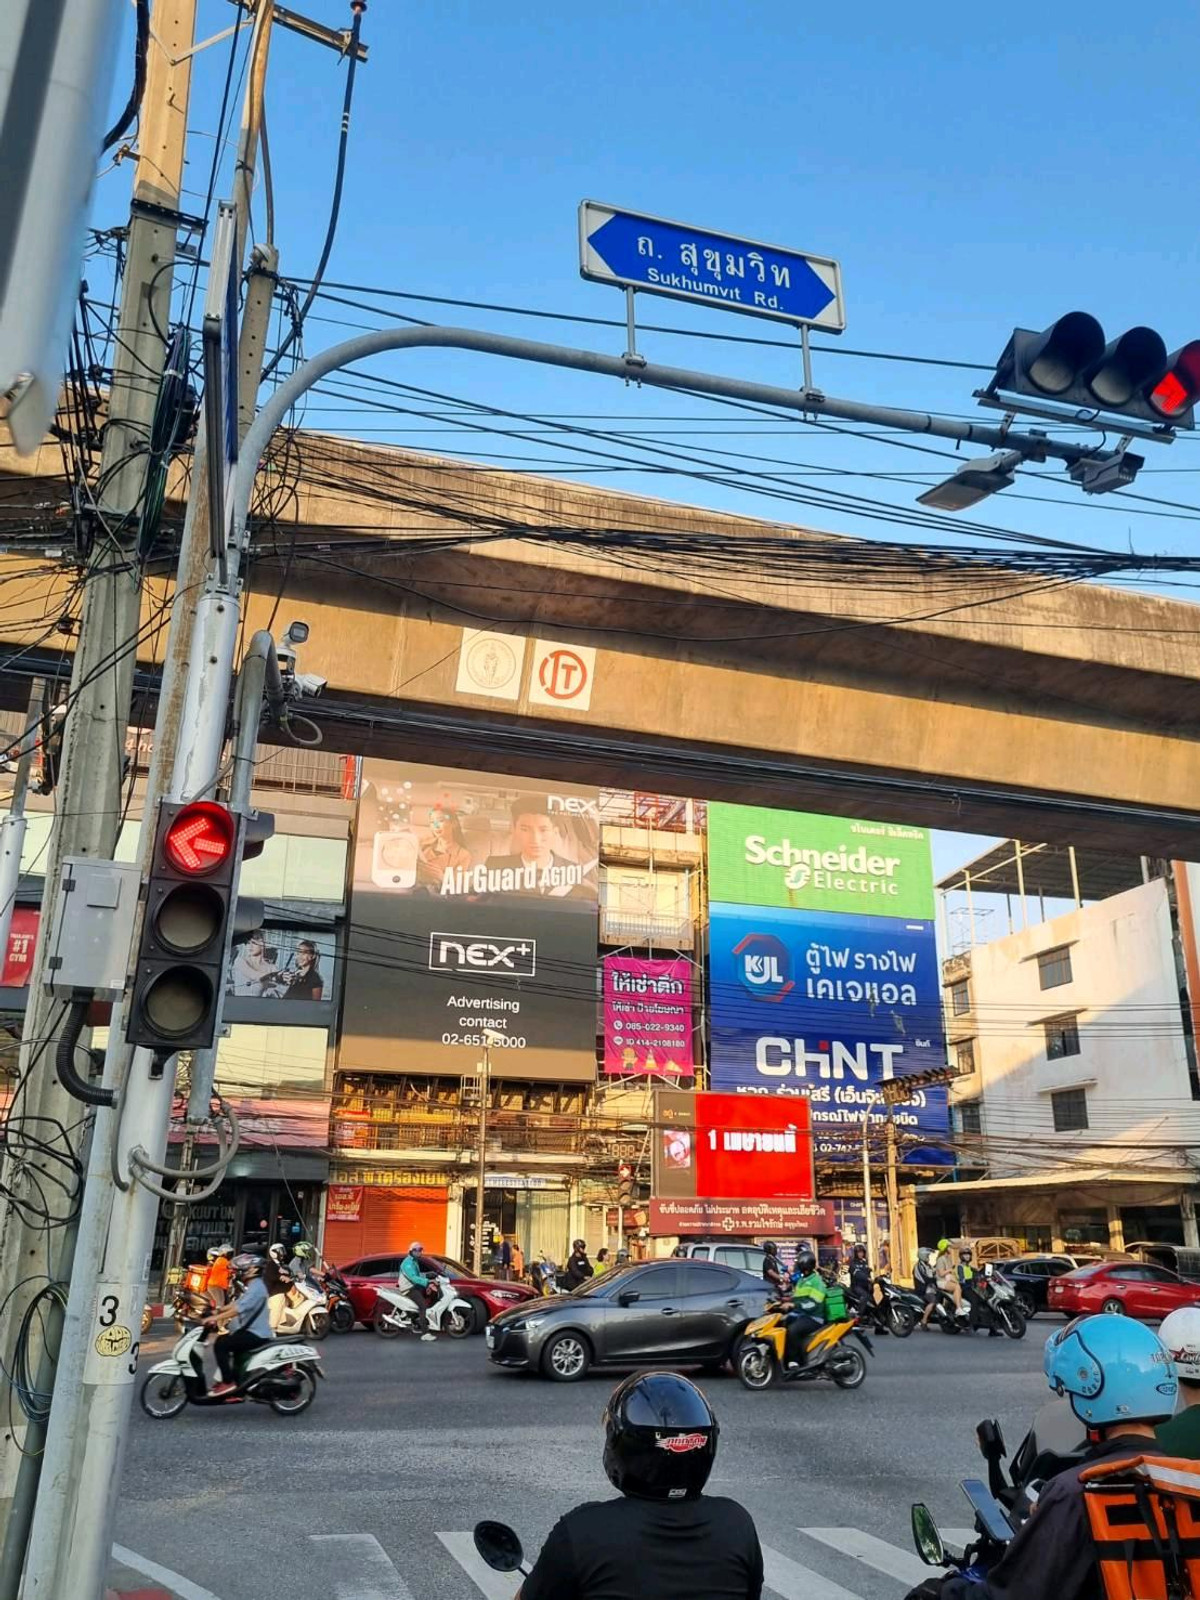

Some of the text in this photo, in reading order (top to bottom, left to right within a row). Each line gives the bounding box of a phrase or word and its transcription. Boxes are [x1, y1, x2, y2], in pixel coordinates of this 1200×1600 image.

[637, 235, 791, 289] ถ. สุขุมวิท
[648, 267, 784, 310] Sukhumvit Rd.
[745, 835, 901, 877] Schneider
[440, 861, 536, 896] AirGuard
[814, 871, 899, 896] Electric
[9, 953, 27, 963] GYM
[805, 942, 916, 975] ตู้ไฟ รางไฟ
[611, 971, 683, 994] ให้เช่าตึก
[806, 977, 917, 1006] เคเจแอล
[447, 995, 520, 1013] Advertising
[459, 1016, 507, 1029] contact
[708, 1129, 717, 1150] 1
[100, 1295, 119, 1327] 3
